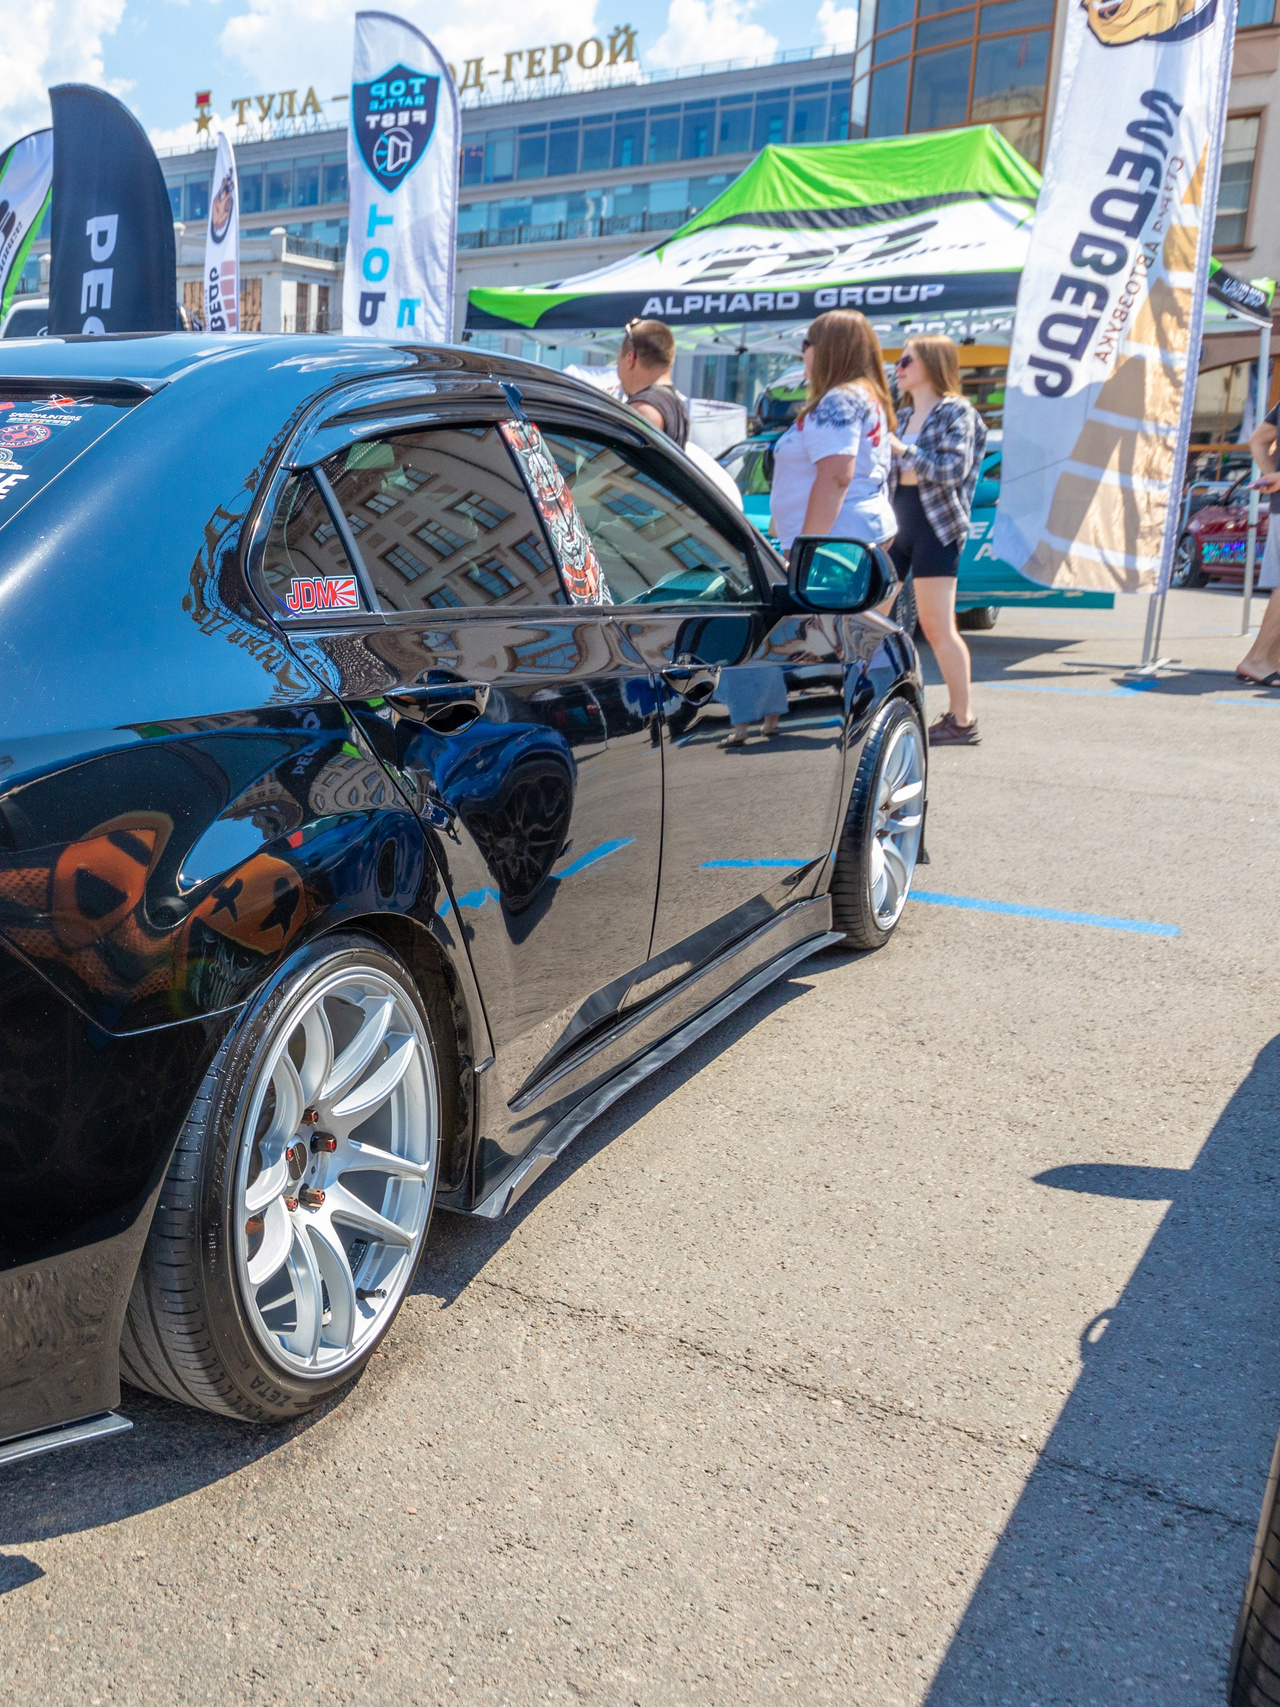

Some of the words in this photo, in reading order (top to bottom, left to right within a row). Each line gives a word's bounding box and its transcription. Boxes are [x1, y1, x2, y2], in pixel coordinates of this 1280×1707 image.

[231, 86, 322, 126] ТУЛА
[450, 24, 638, 93] Д-ГЕРОЙ
[641, 290, 801, 317] ALPHARD
[813, 284, 945, 309] GROUP
[289, 580, 338, 610] JDM
[249, 1374, 293, 1408] ZETA
